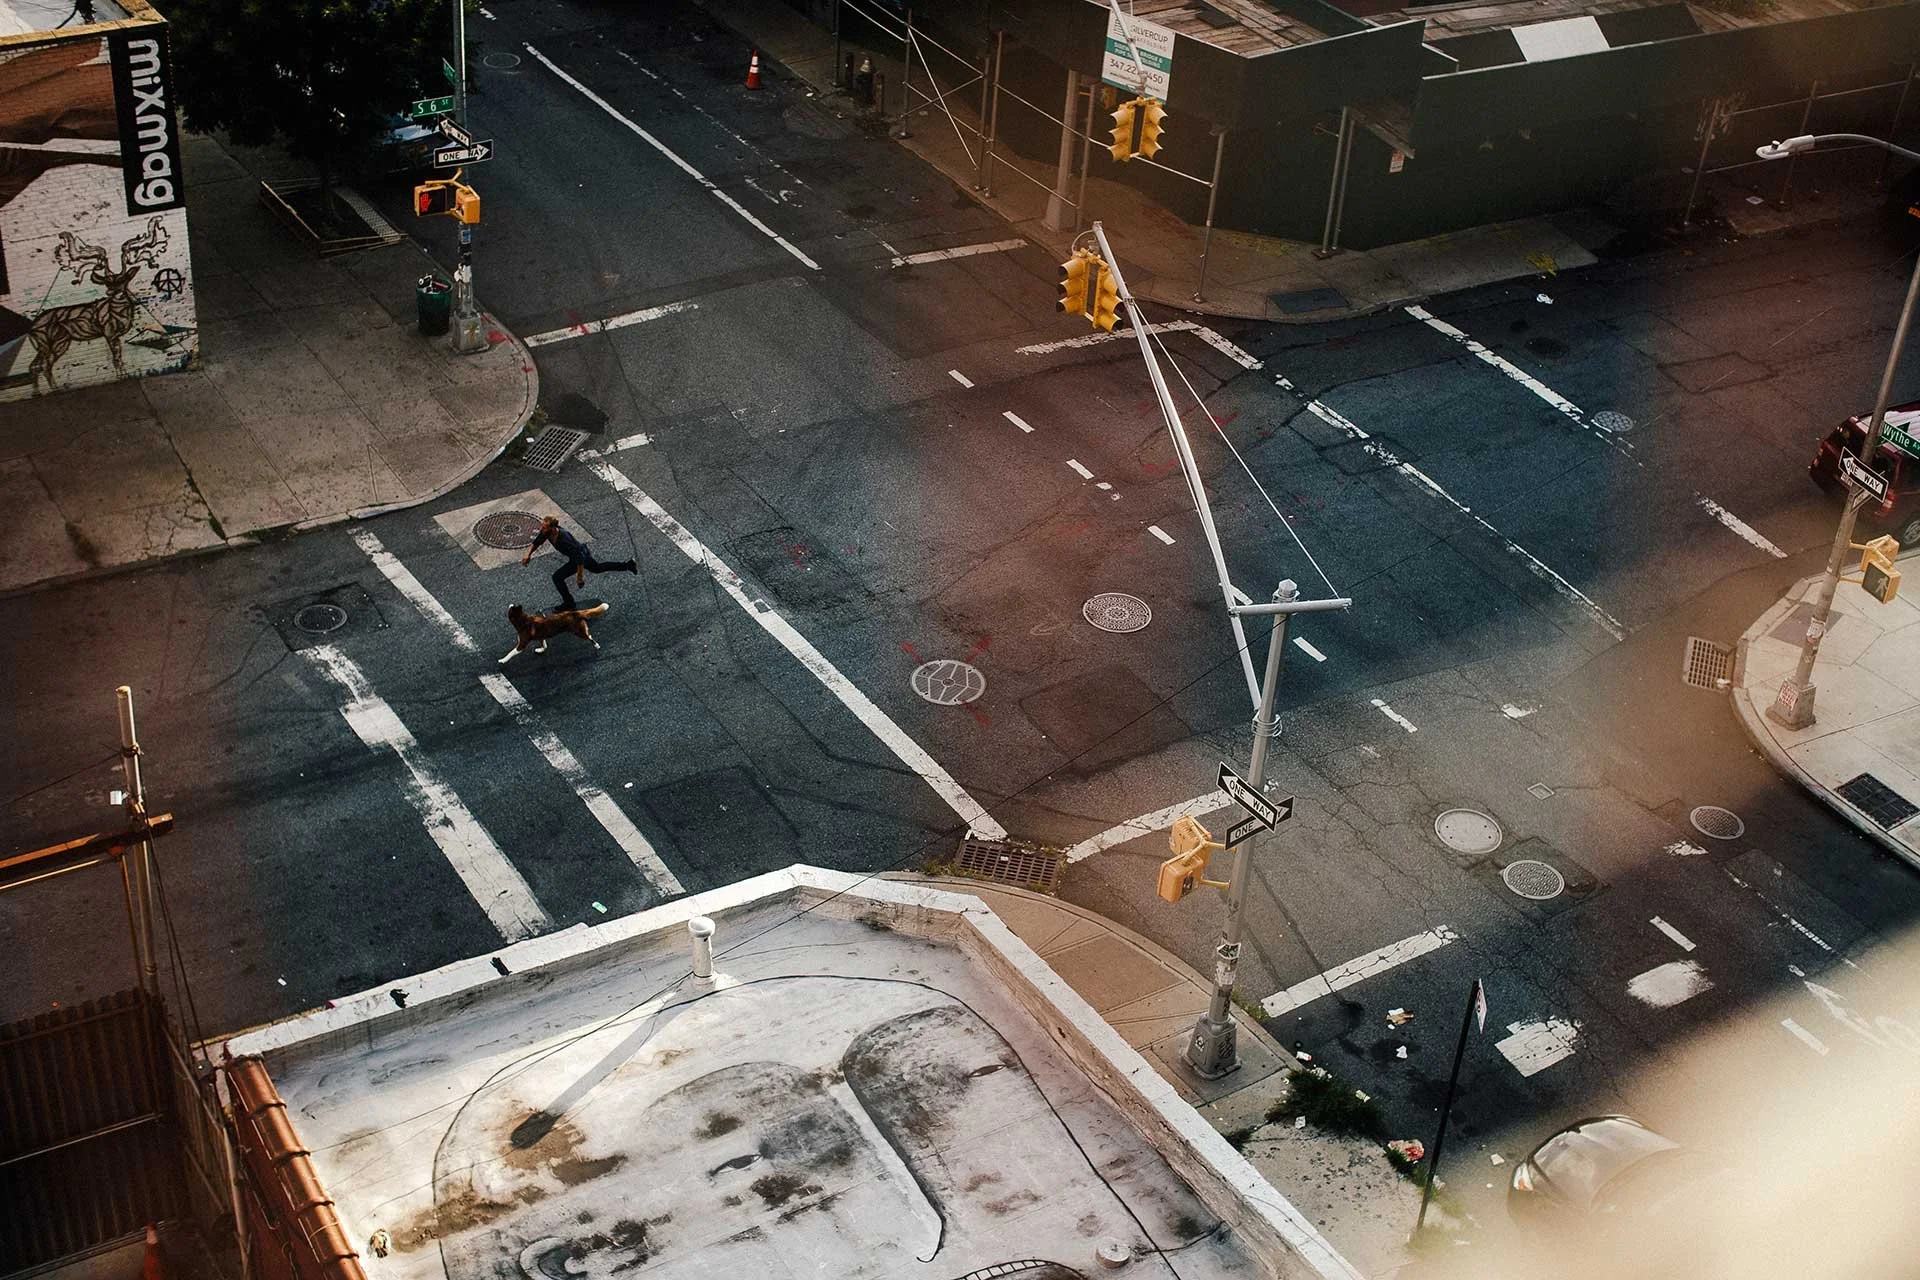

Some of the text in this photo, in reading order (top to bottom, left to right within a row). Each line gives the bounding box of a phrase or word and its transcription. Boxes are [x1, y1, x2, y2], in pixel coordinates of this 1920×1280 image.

[418, 103, 424, 113] S
[430, 101, 437, 111] 6
[128, 38, 175, 207] mixmag
[443, 152, 460, 161] ONE
[1884, 424, 1910, 447] Wythe
[1846, 460, 1859, 476] ONE
[1864, 474, 1881, 490] WAY
[1229, 780, 1245, 800] ONE
[1253, 798, 1271, 818] WAY
[1235, 821, 1254, 839] ONE
